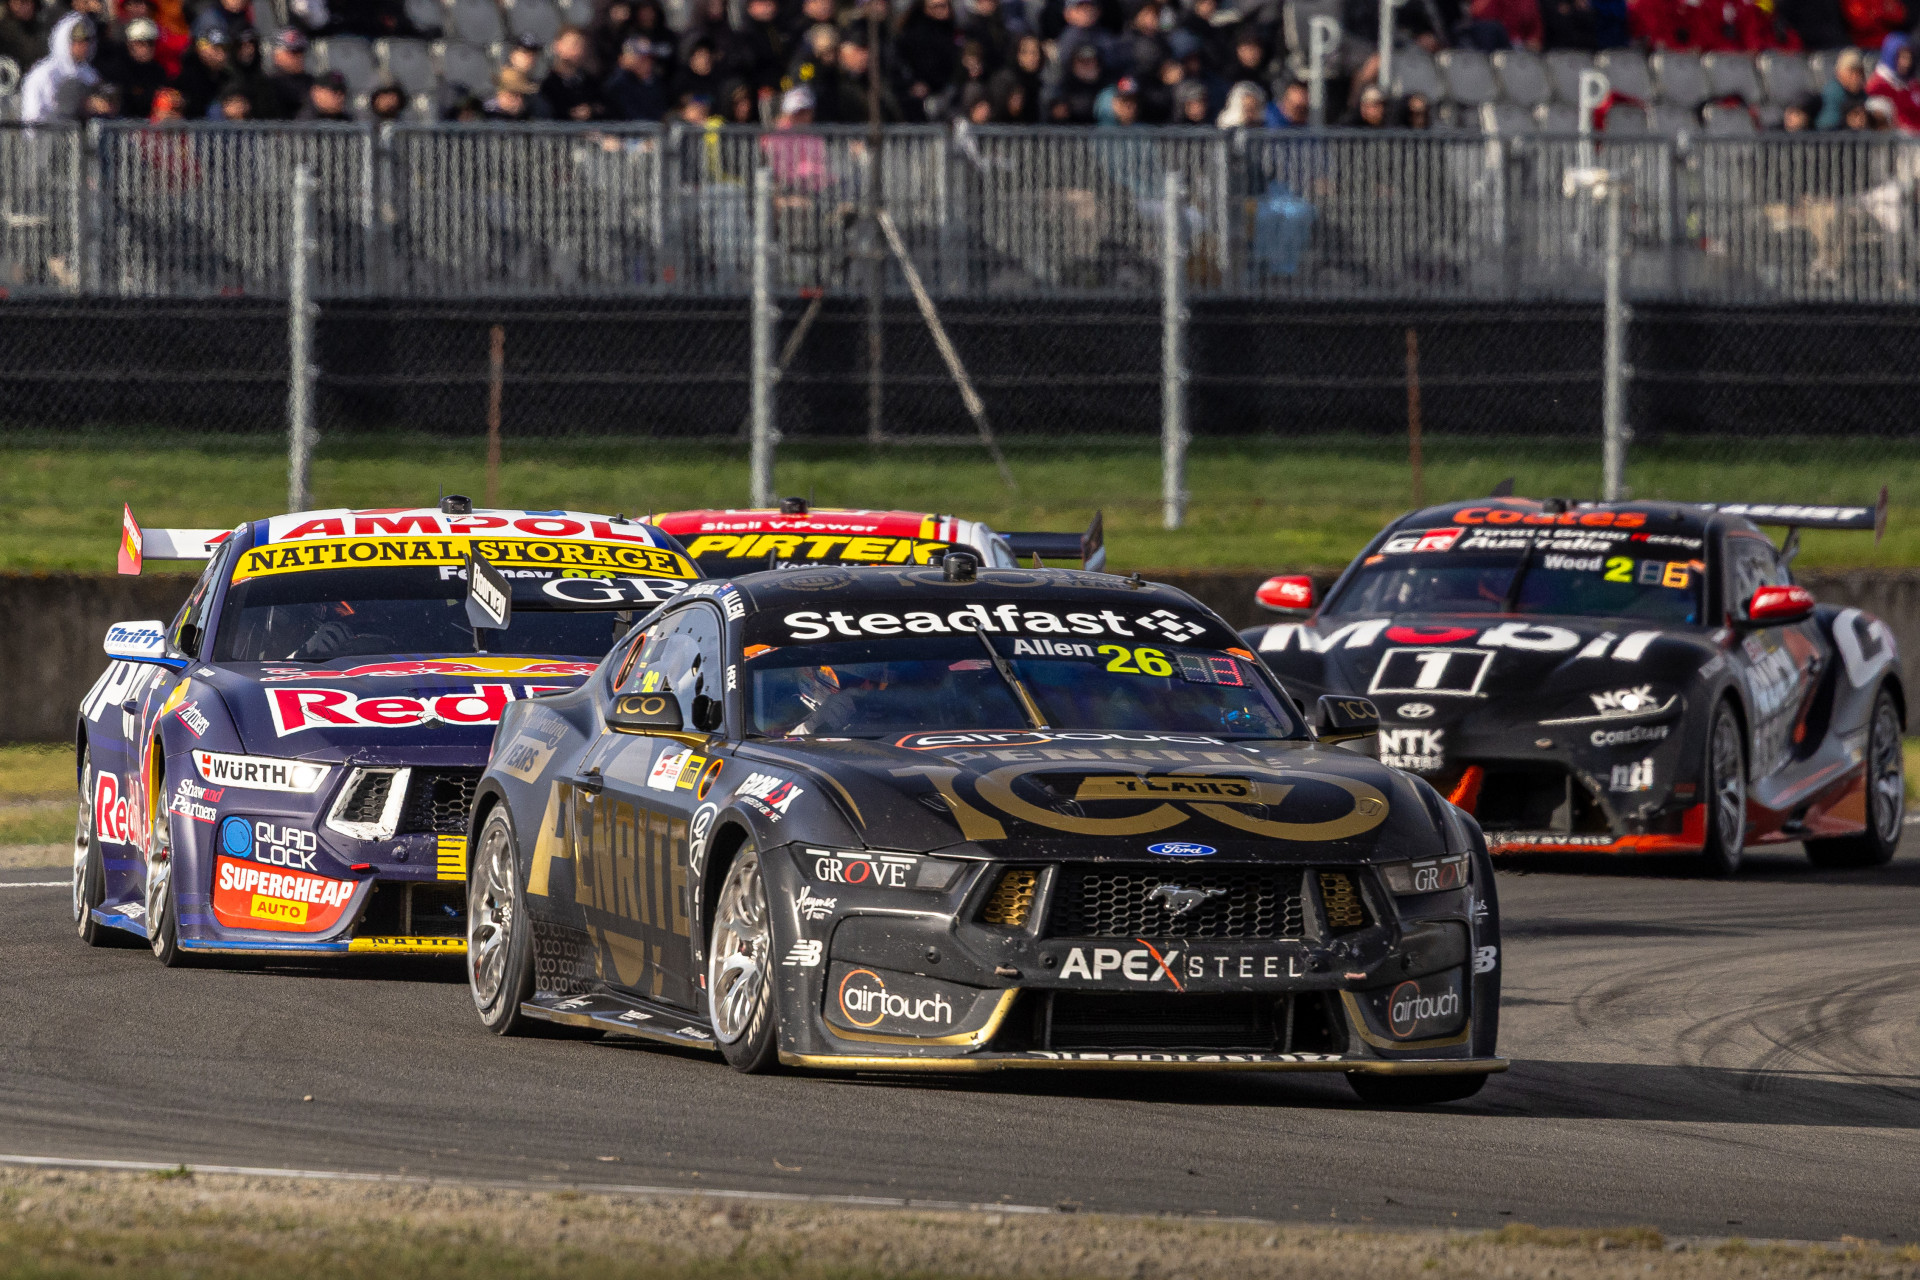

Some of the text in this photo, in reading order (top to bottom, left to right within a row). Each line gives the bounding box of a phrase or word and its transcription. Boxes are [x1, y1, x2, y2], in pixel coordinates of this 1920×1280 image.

[281, 514, 645, 543] AMPOL
[701, 521, 878, 533] Shell V-Power
[1453, 507, 1647, 528] Coates
[248, 540, 675, 574] NATIONAL STORAGE
[687, 534, 950, 565] PIRTEK
[1383, 535, 1454, 552] GR
[1460, 535, 1613, 552] Ausralia
[438, 565, 554, 581] Feney
[1544, 554, 1634, 583] Wood 2
[783, 604, 1135, 641] Steadfast
[106, 627, 166, 649] Thrifty
[1257, 619, 1663, 661] Mobil
[1013, 639, 1173, 677] Allen 26
[1414, 652, 1453, 689] 1
[726, 664, 737, 692] HRX
[1379, 727, 1445, 755] NTK
[213, 759, 287, 785] WÜRTH
[177, 779, 224, 803] Shaw and
[170, 794, 216, 821] Partners
[255, 822, 317, 851] QUAD
[1160, 843, 1203, 855] Ford
[255, 842, 318, 871] LOCK
[527, 780, 691, 937] PENRITE
[219, 863, 355, 908] SUPERCHEAP
[815, 858, 907, 888] GROVE
[1414, 861, 1470, 892] GROV
[257, 900, 301, 918] AUTO
[1059, 946, 1304, 983] APEX STEEL
[845, 985, 952, 1024] airtouch
[1392, 986, 1459, 1023] airtouch
